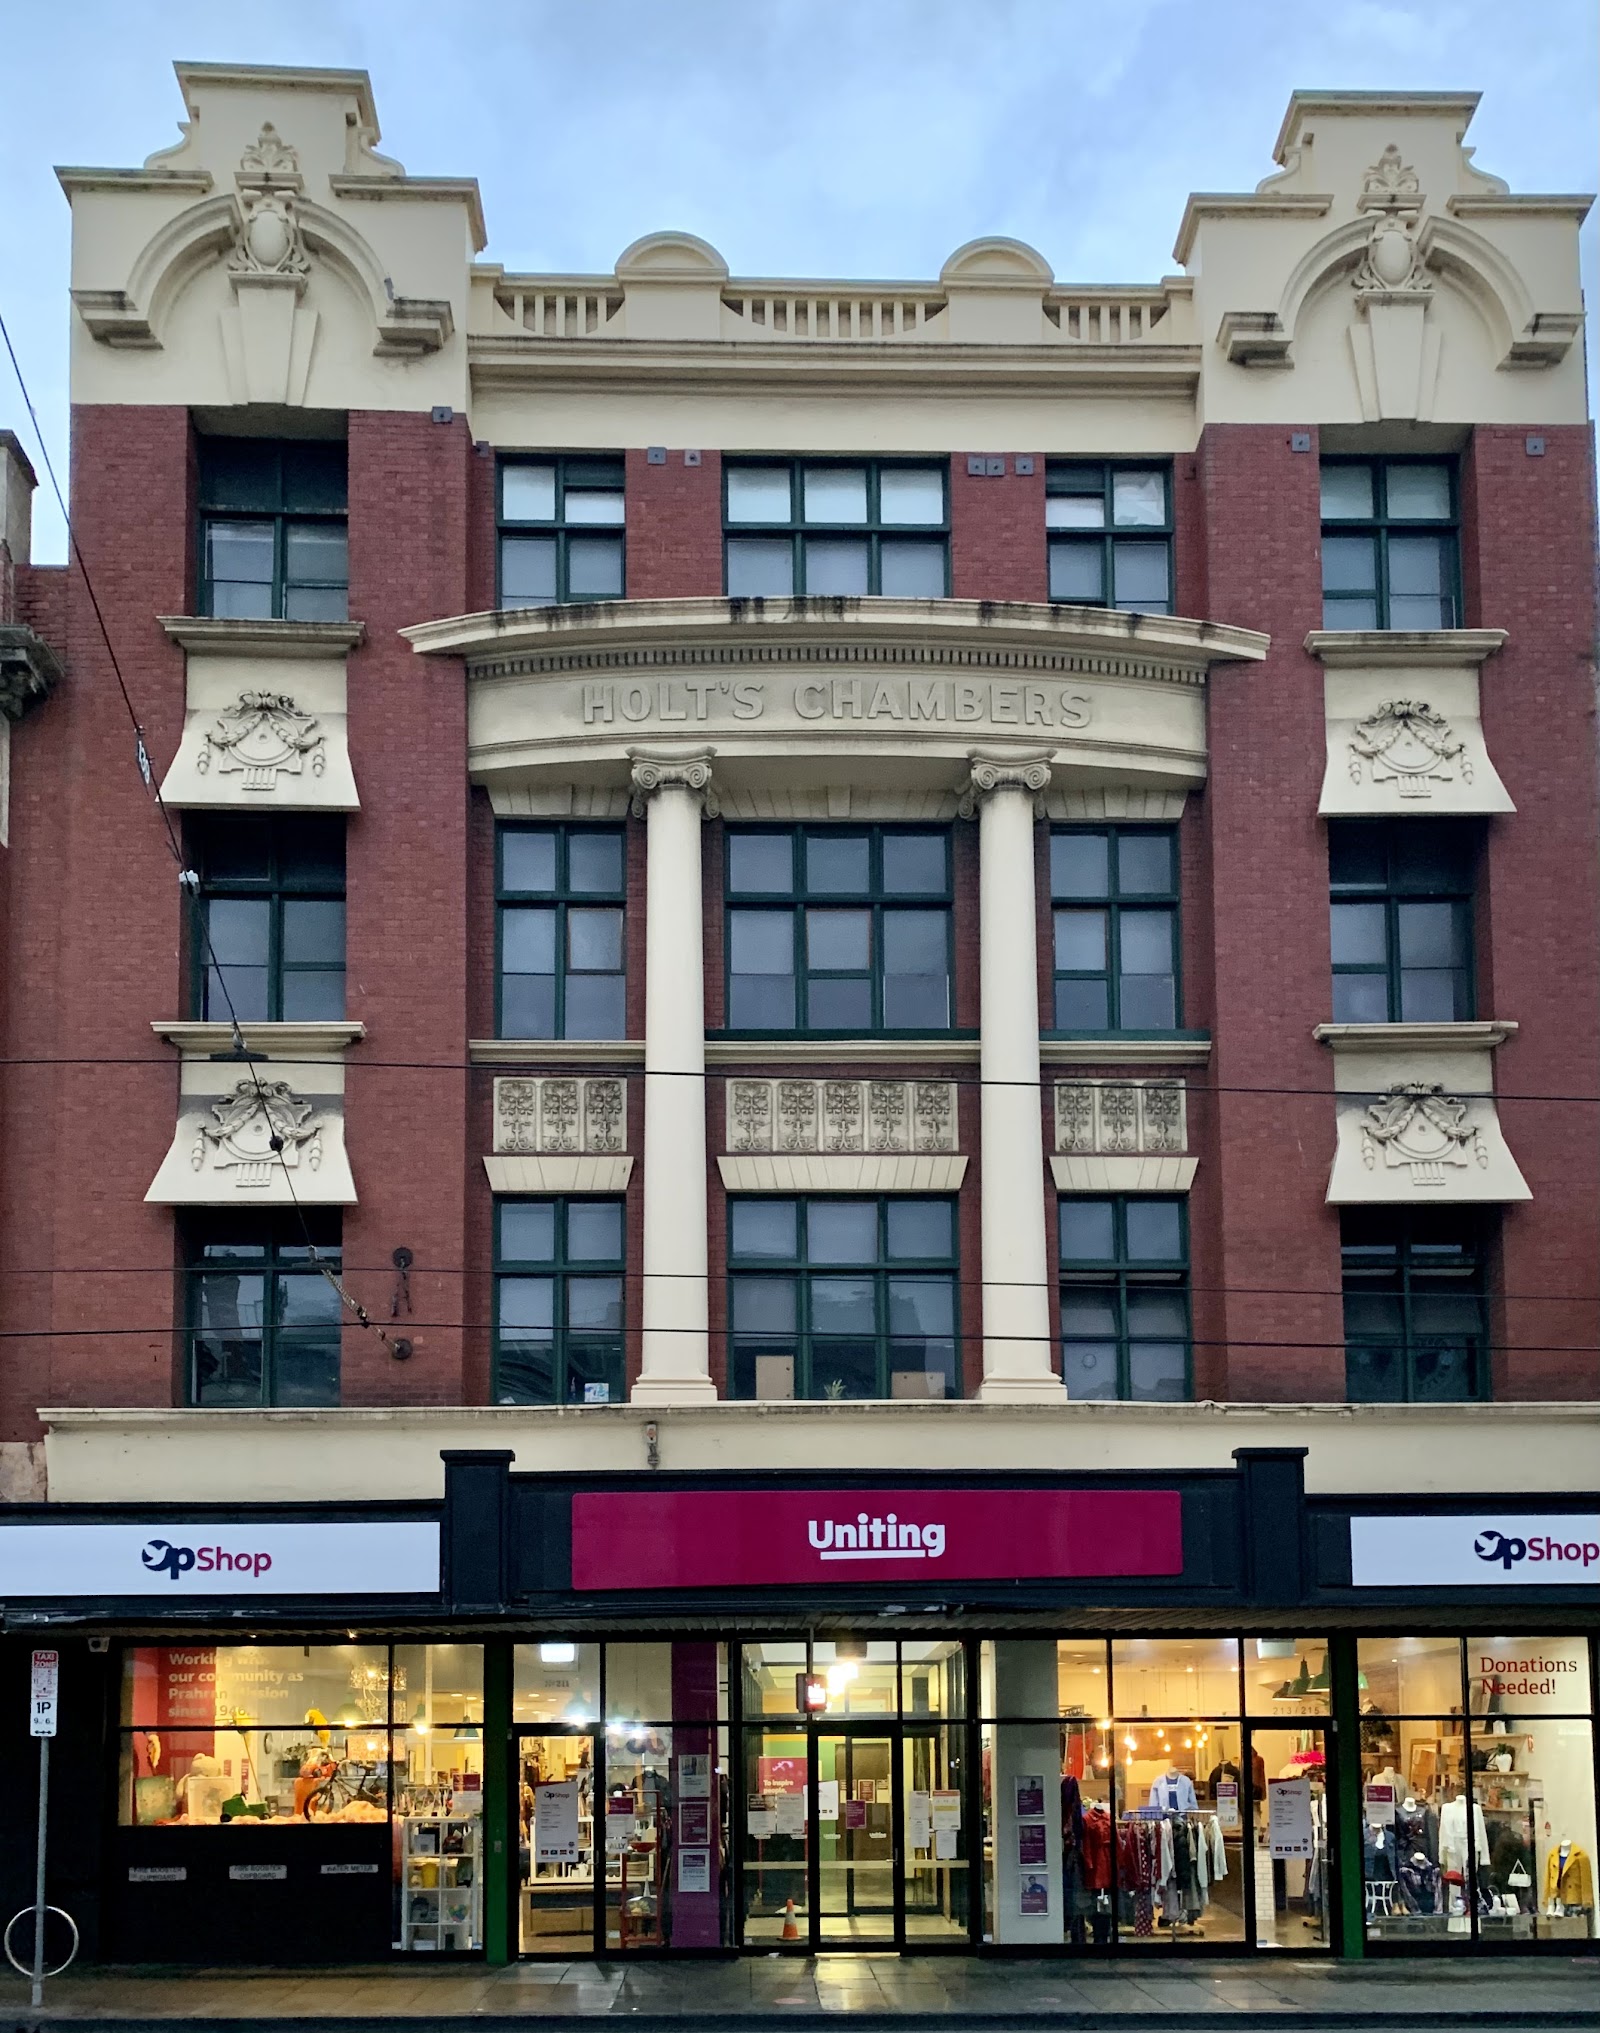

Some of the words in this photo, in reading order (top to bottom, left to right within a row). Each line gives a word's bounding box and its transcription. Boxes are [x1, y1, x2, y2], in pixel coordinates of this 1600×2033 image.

[582, 681, 765, 724] HOLT'S
[794, 679, 1093, 729] CHAMBERS
[808, 1512, 946, 1559] Uniting
[1480, 1656, 1578, 1673] Donations
[168, 1672, 194, 1683] our
[287, 1672, 304, 1682] as
[1481, 1678, 1556, 1695] Needed!
[36, 1701, 51, 1714] 1P
